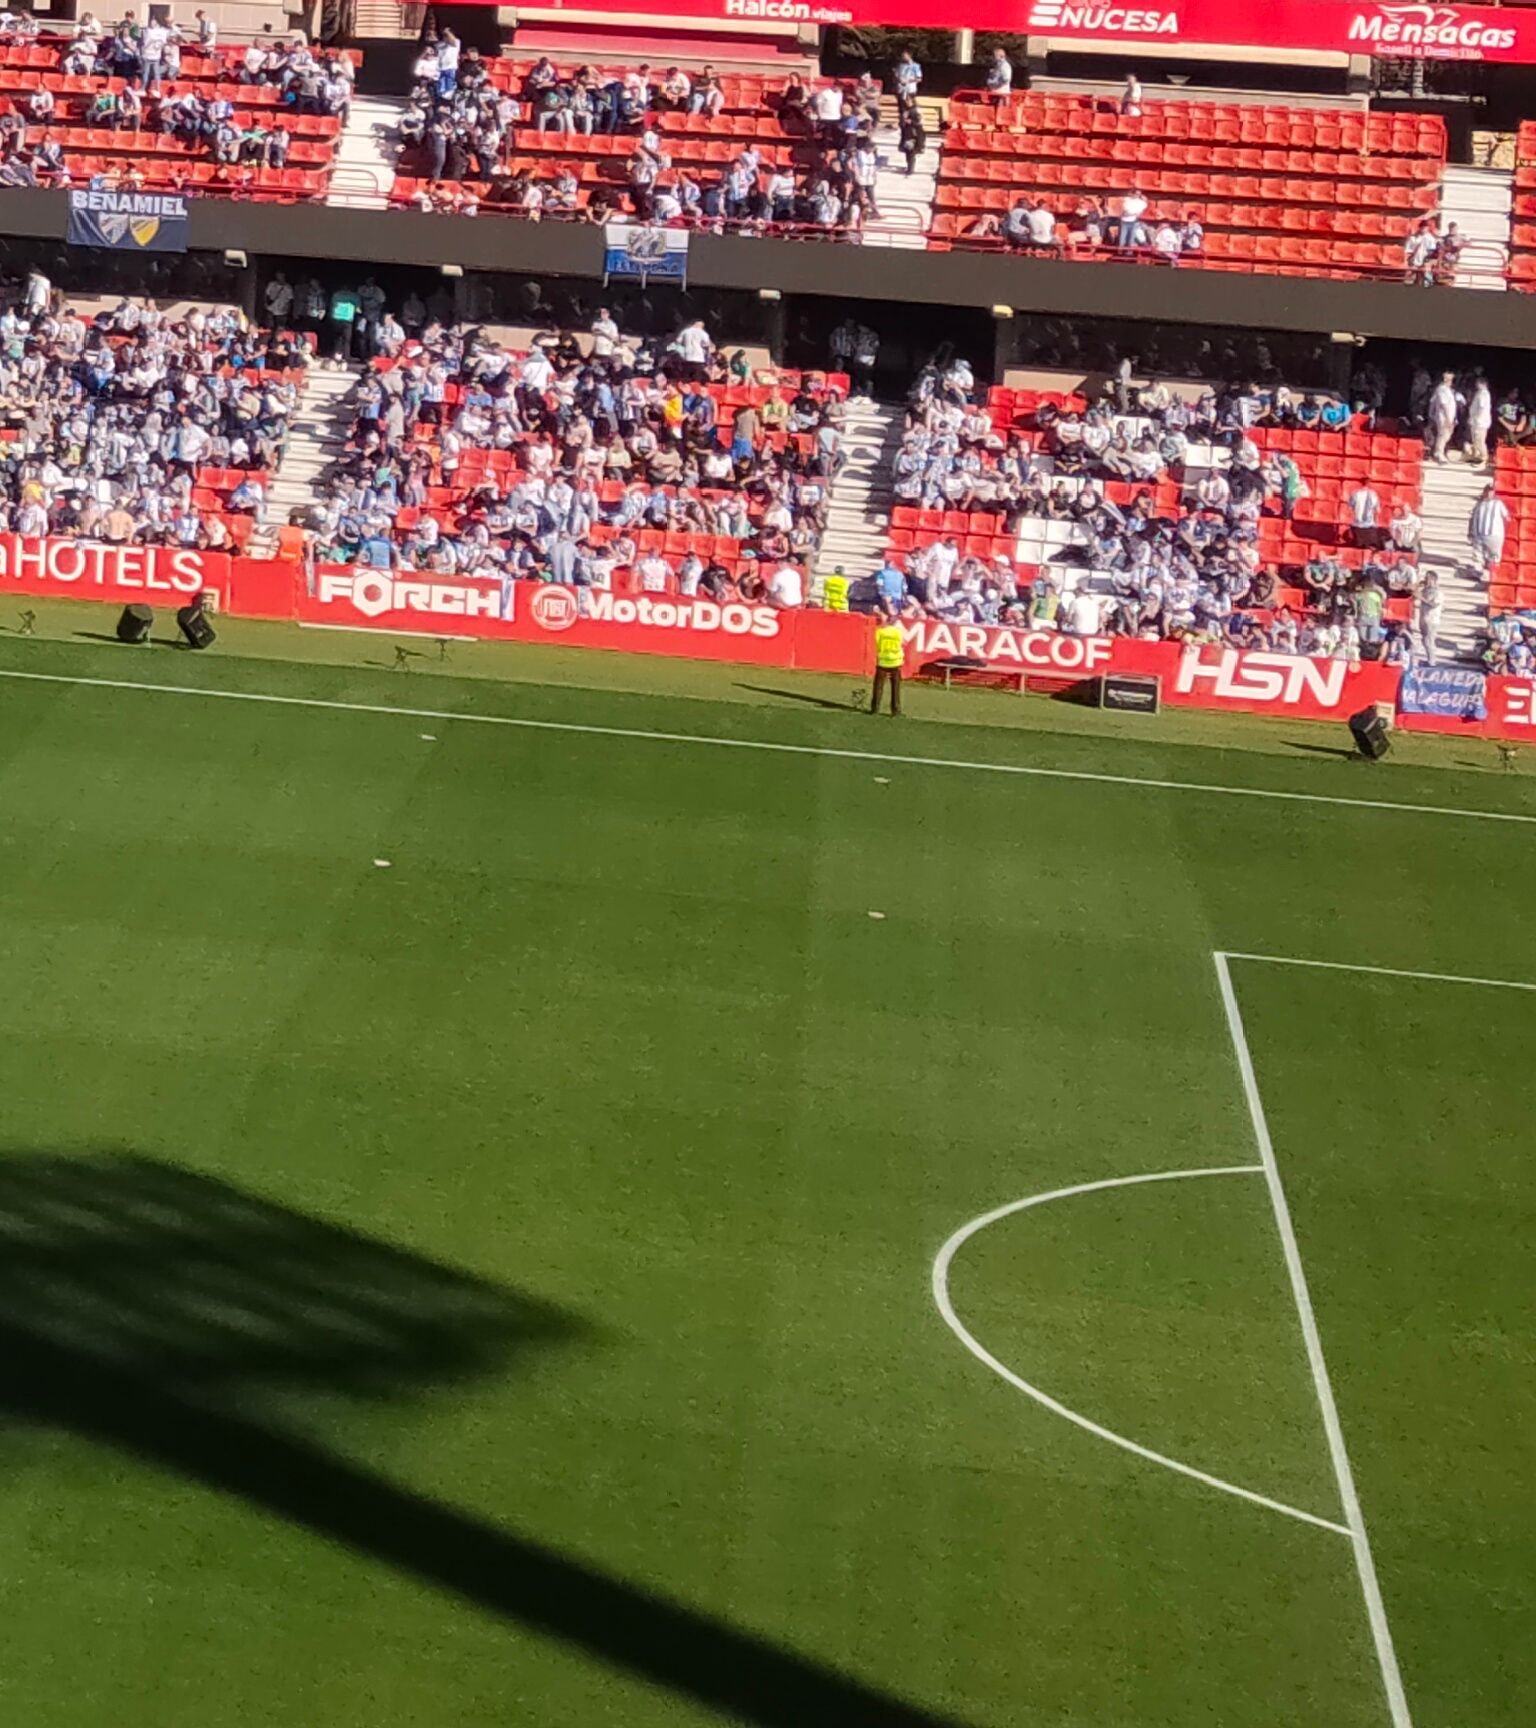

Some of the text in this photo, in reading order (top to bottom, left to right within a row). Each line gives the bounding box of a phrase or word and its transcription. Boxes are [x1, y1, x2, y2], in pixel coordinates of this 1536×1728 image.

[1059, 5, 1178, 33] NUCESA
[1348, 14, 1517, 48] MensaGas
[72, 190, 188, 217] BENAMIEL
[585, 591, 780, 638] MotorDOS
[900, 621, 1114, 669] MARACOF
[1177, 645, 1346, 707] HSN
